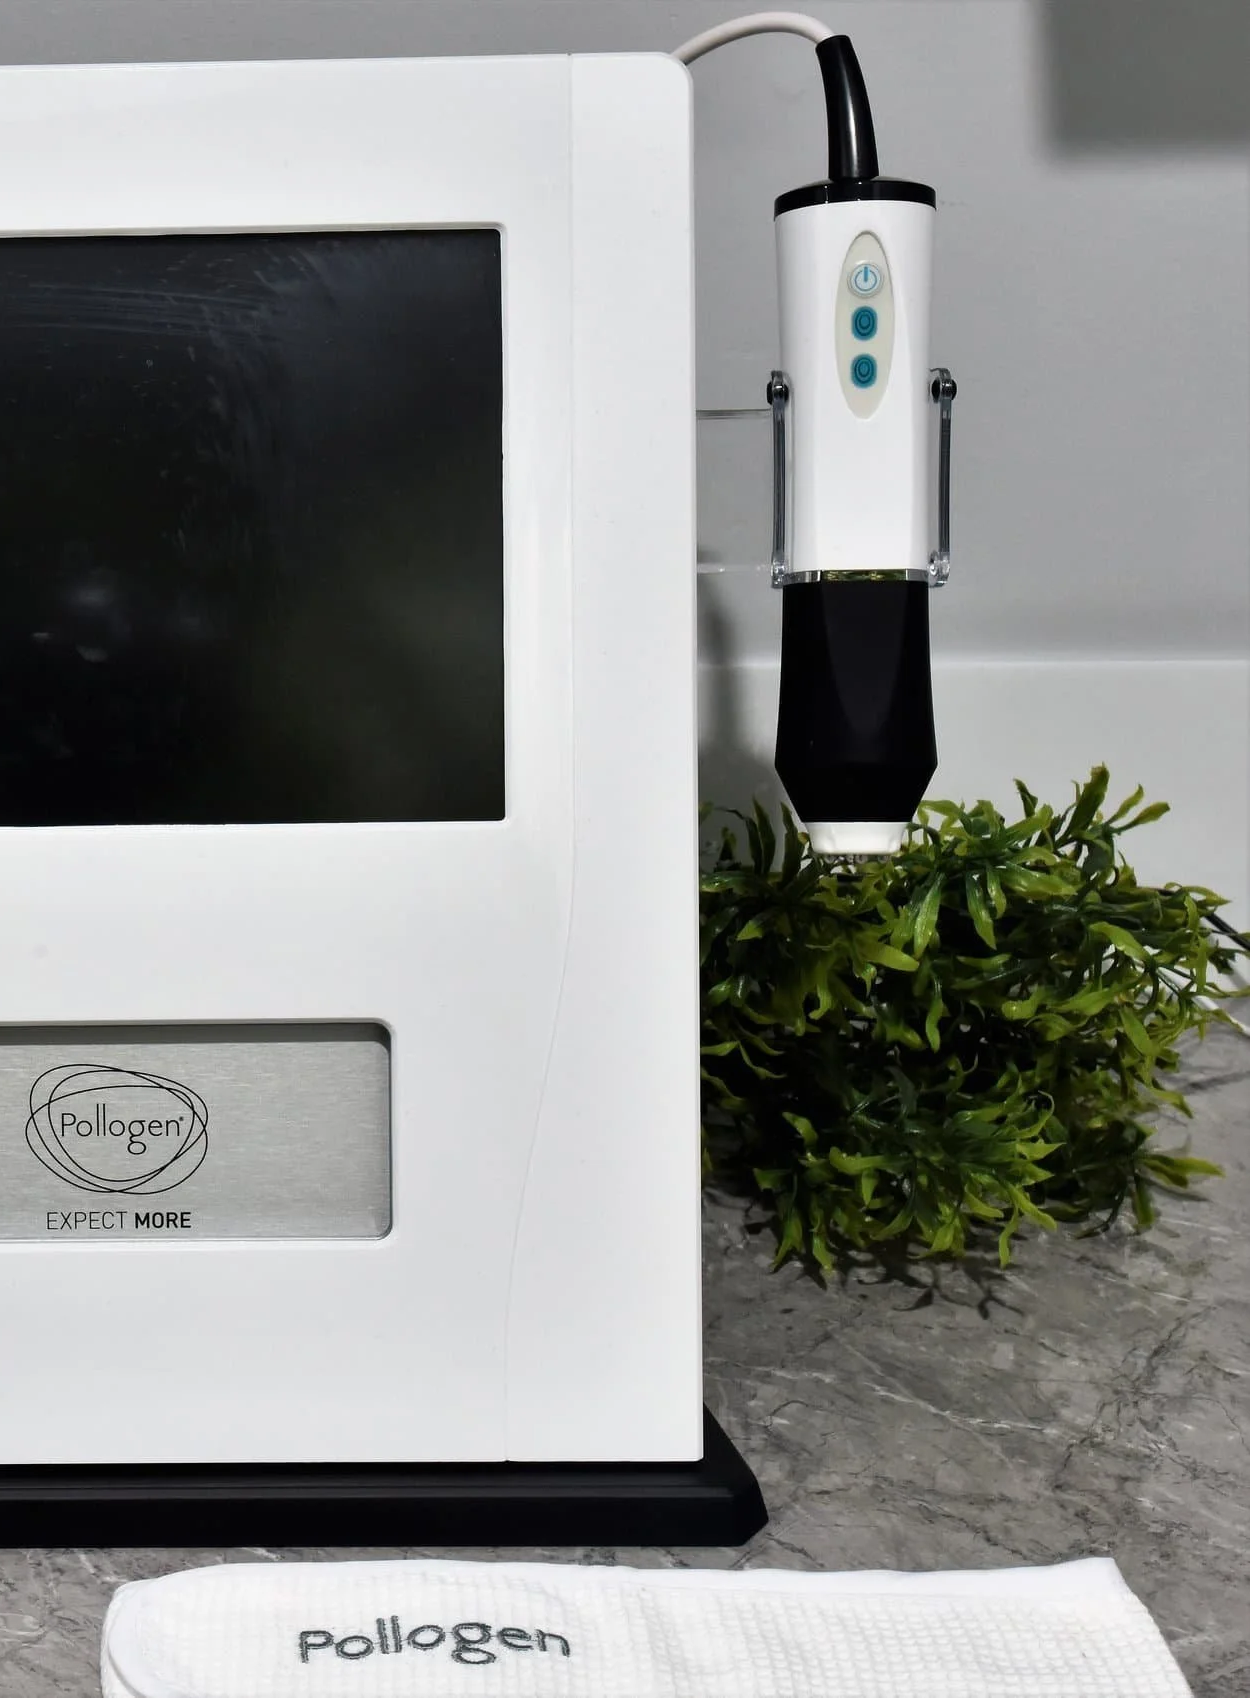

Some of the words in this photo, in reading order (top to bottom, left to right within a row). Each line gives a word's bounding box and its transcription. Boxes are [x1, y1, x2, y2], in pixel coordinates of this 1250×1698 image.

[60, 1103, 181, 1155] Pollogen
[46, 1210, 128, 1230] EXPECT
[134, 1211, 192, 1230] MORE
[300, 1615, 571, 1665] Pollogen
